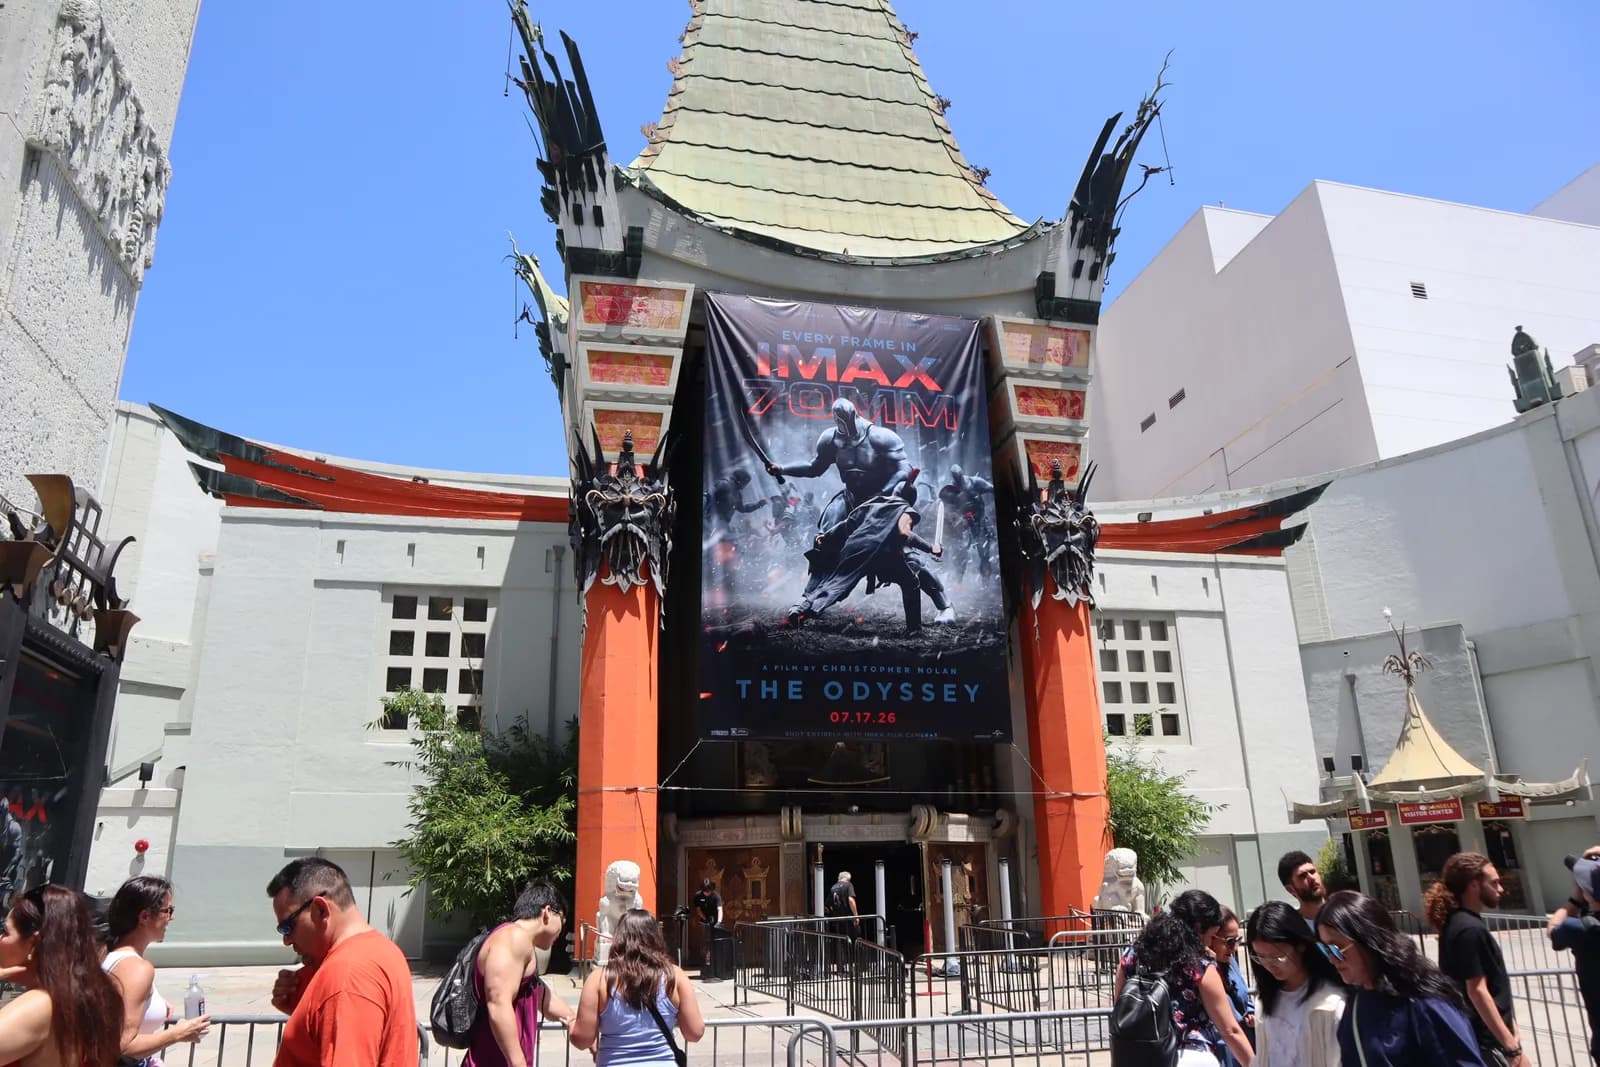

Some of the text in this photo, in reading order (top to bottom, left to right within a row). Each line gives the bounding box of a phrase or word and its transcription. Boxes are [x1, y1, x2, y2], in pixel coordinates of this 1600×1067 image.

[782, 330, 917, 353] EVERY FRAME IN
[756, 342, 943, 392] IMAX
[743, 378, 958, 431] 70MM
[822, 664, 911, 674] CHRISTOPHER
[917, 667, 957, 675] NOLAN
[736, 679, 981, 703] THE ODYSSEY
[830, 711, 897, 724] 07.17.26
[1404, 808, 1454, 818] VISITOR CENTER
